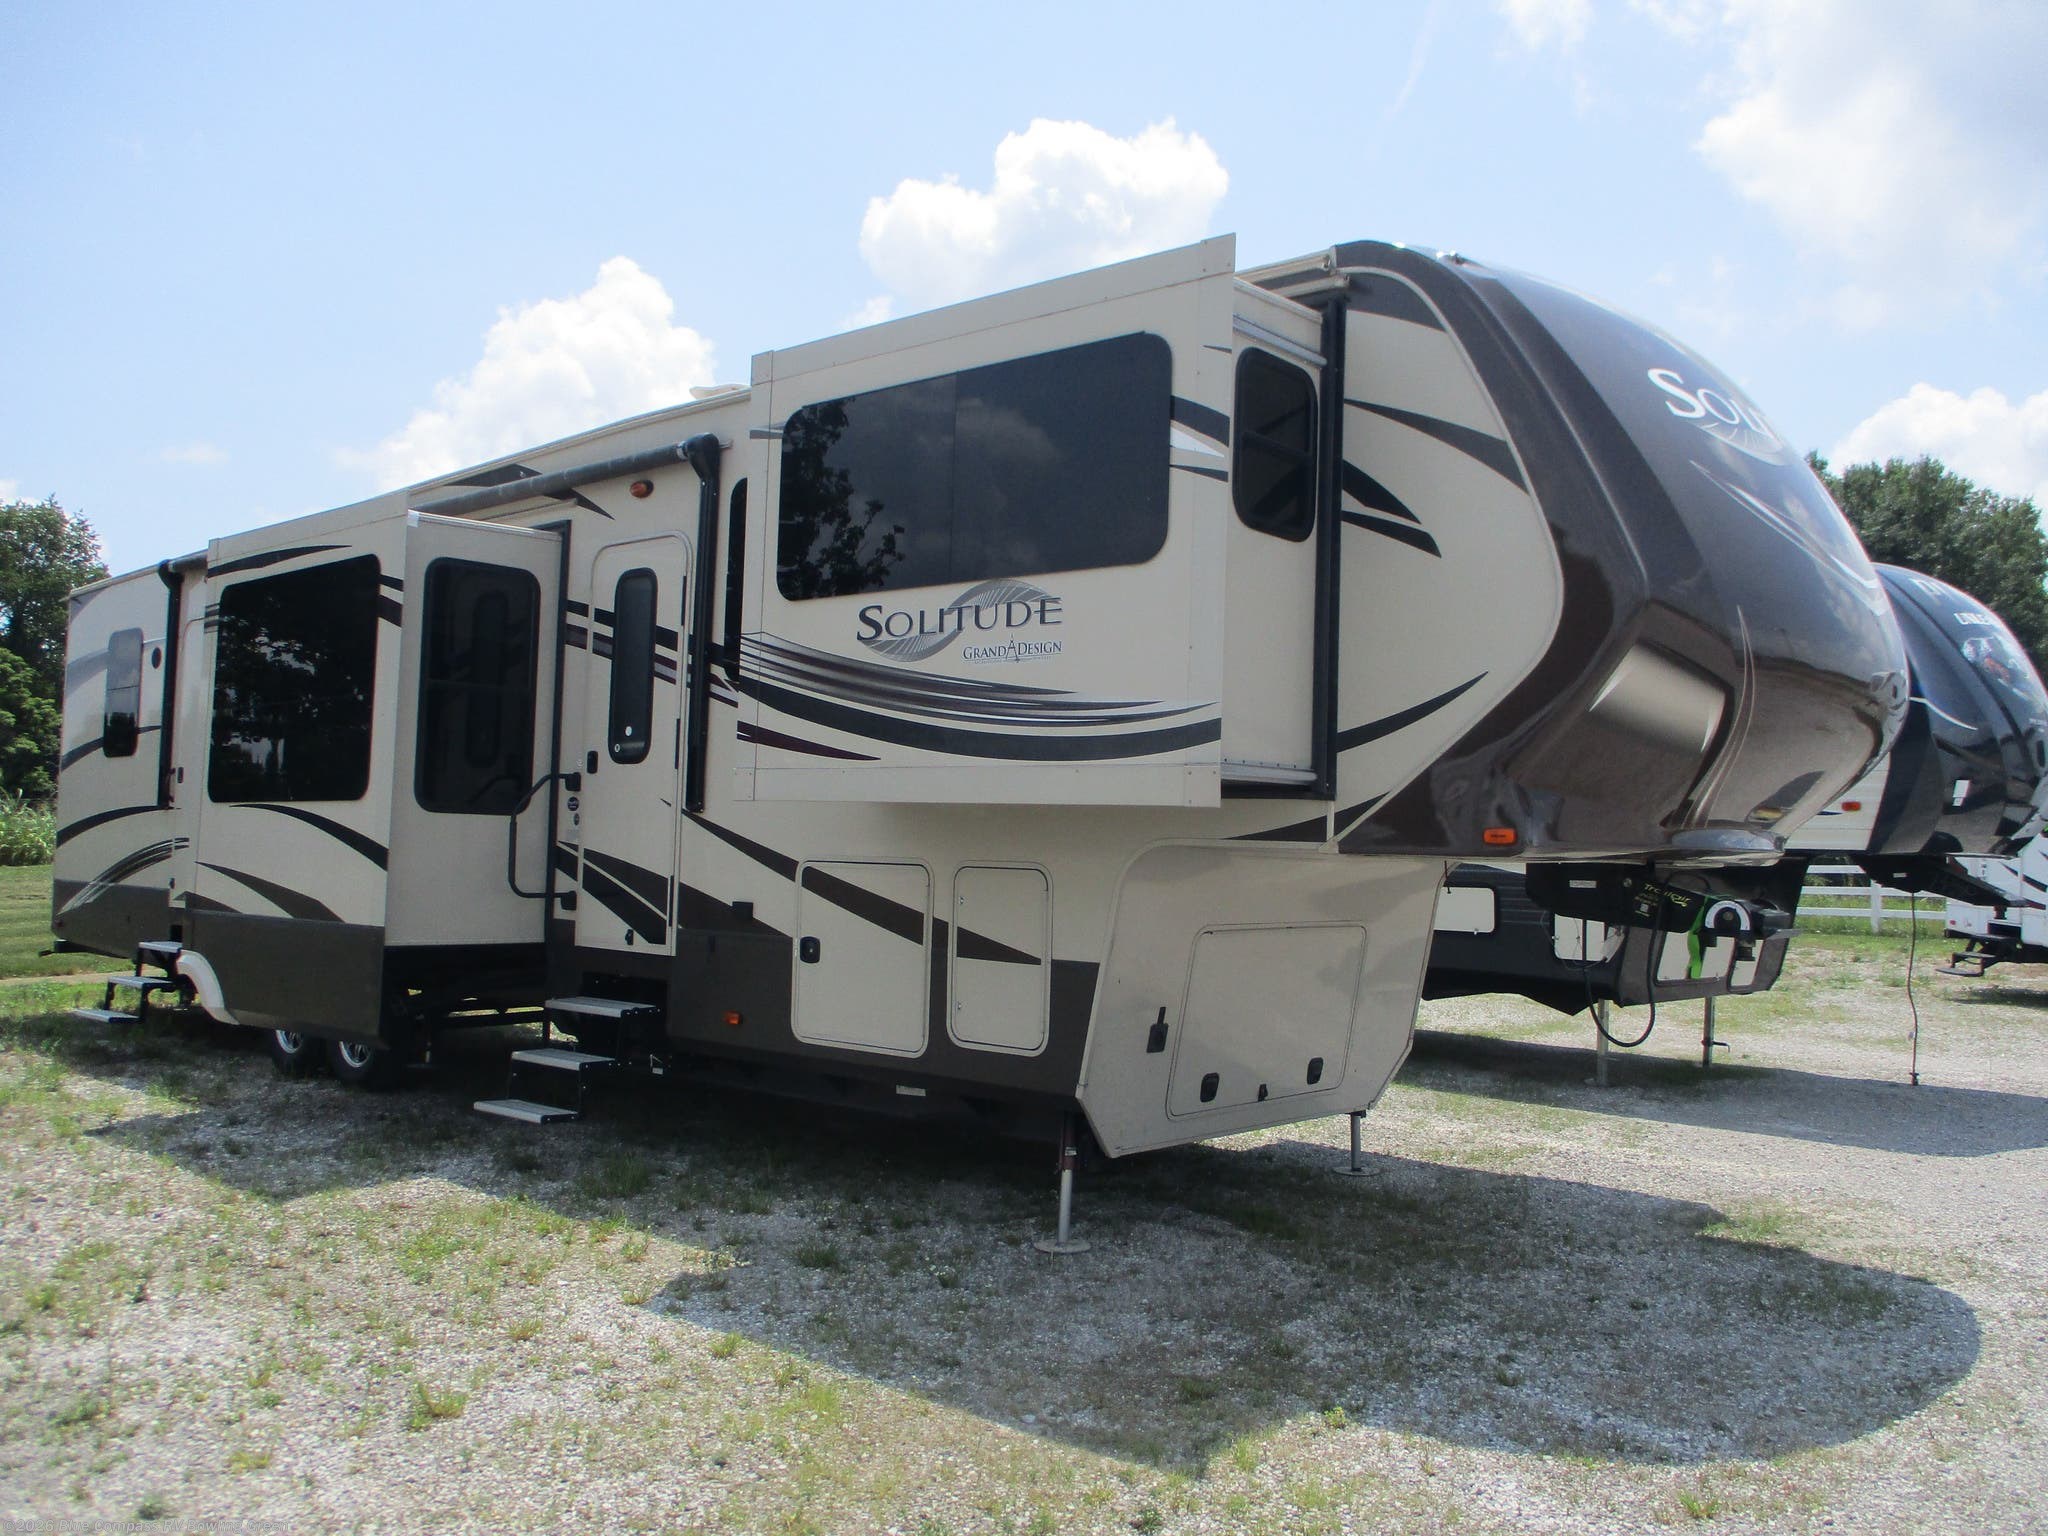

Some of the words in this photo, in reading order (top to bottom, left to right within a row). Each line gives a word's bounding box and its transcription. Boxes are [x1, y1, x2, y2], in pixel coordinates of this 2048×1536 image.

[856, 596, 1063, 641] SOLITUDE
[962, 644, 1006, 660] GRAND
[1017, 640, 1062, 655] DESIGN
